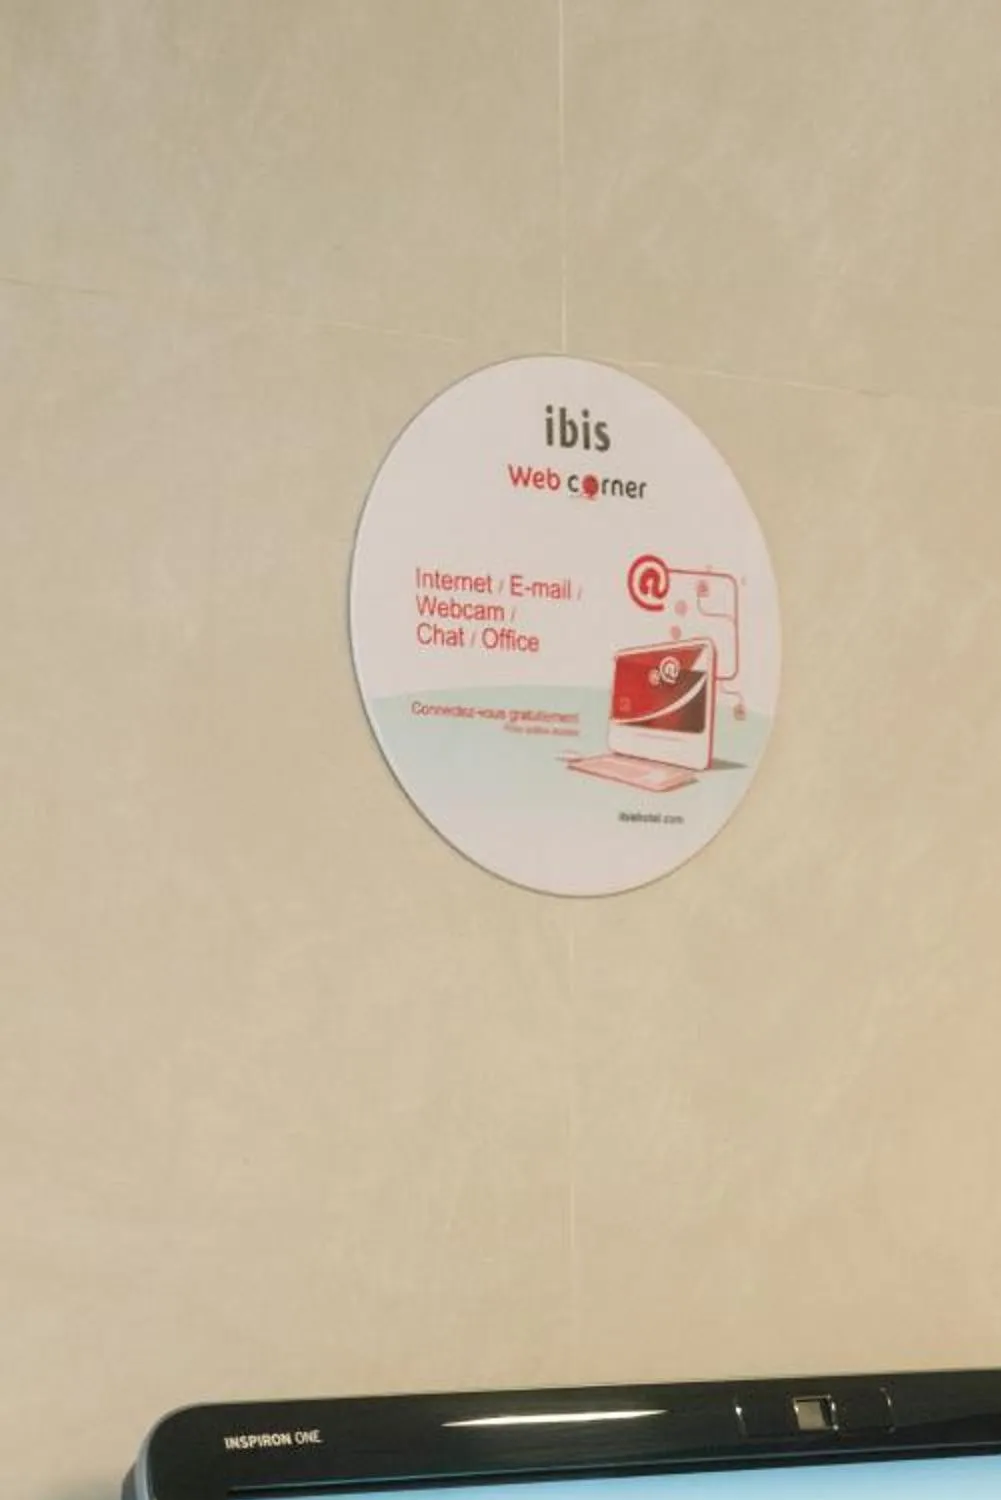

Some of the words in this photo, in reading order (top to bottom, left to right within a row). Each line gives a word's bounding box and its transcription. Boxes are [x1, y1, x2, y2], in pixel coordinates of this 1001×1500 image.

[545, 404, 611, 452] ibis
[508, 463, 561, 490] Web
[416, 567, 493, 594] Internet
[510, 574, 572, 600] E-mail
[416, 594, 505, 621] Webcam
[416, 622, 465, 648] Chat
[481, 627, 540, 652] Office
[224, 1433, 292, 1450] INSPIRON
[294, 1428, 322, 1445] ONE
